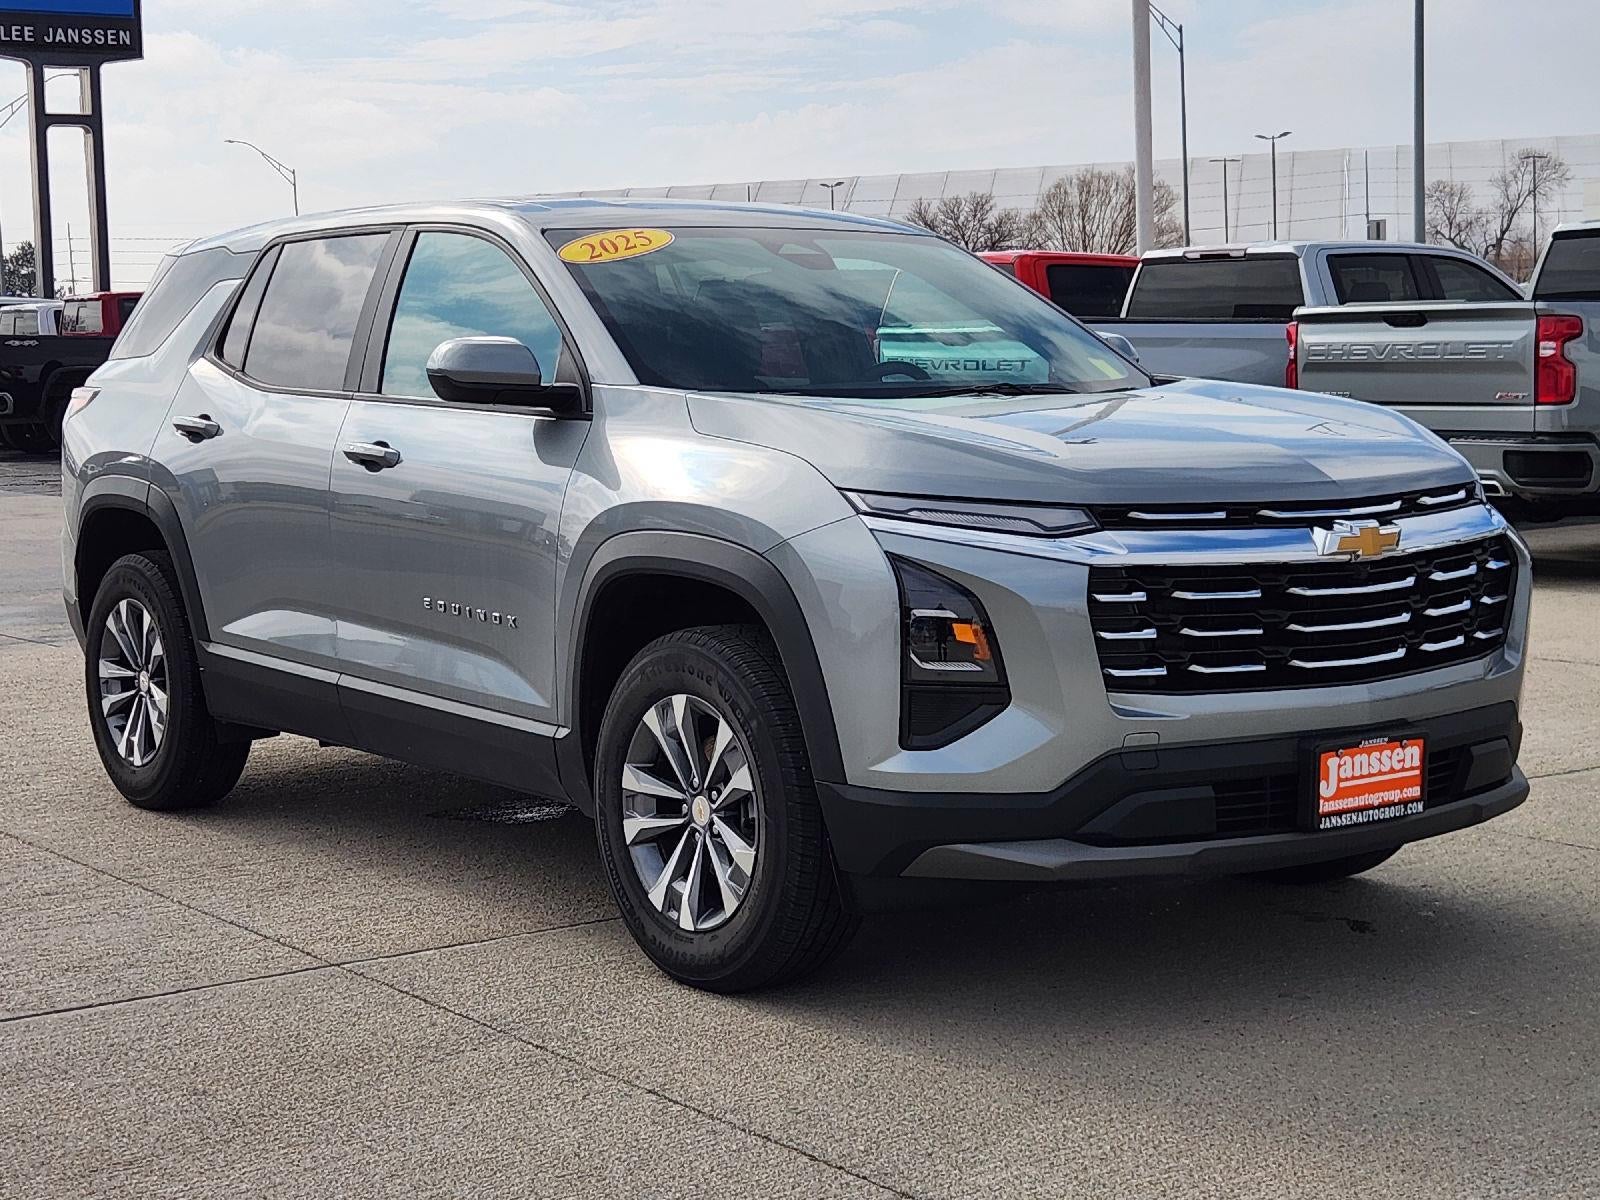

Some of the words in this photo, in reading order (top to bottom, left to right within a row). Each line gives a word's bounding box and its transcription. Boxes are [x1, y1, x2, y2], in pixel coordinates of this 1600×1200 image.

[0, 25, 35, 42] LEE
[44, 27, 131, 45] JANSSEN
[580, 231, 653, 260] 2025
[1306, 343, 1514, 361] CHEVROLET
[423, 597, 518, 628] EQUINOX
[1320, 745, 1420, 798] Janssen
